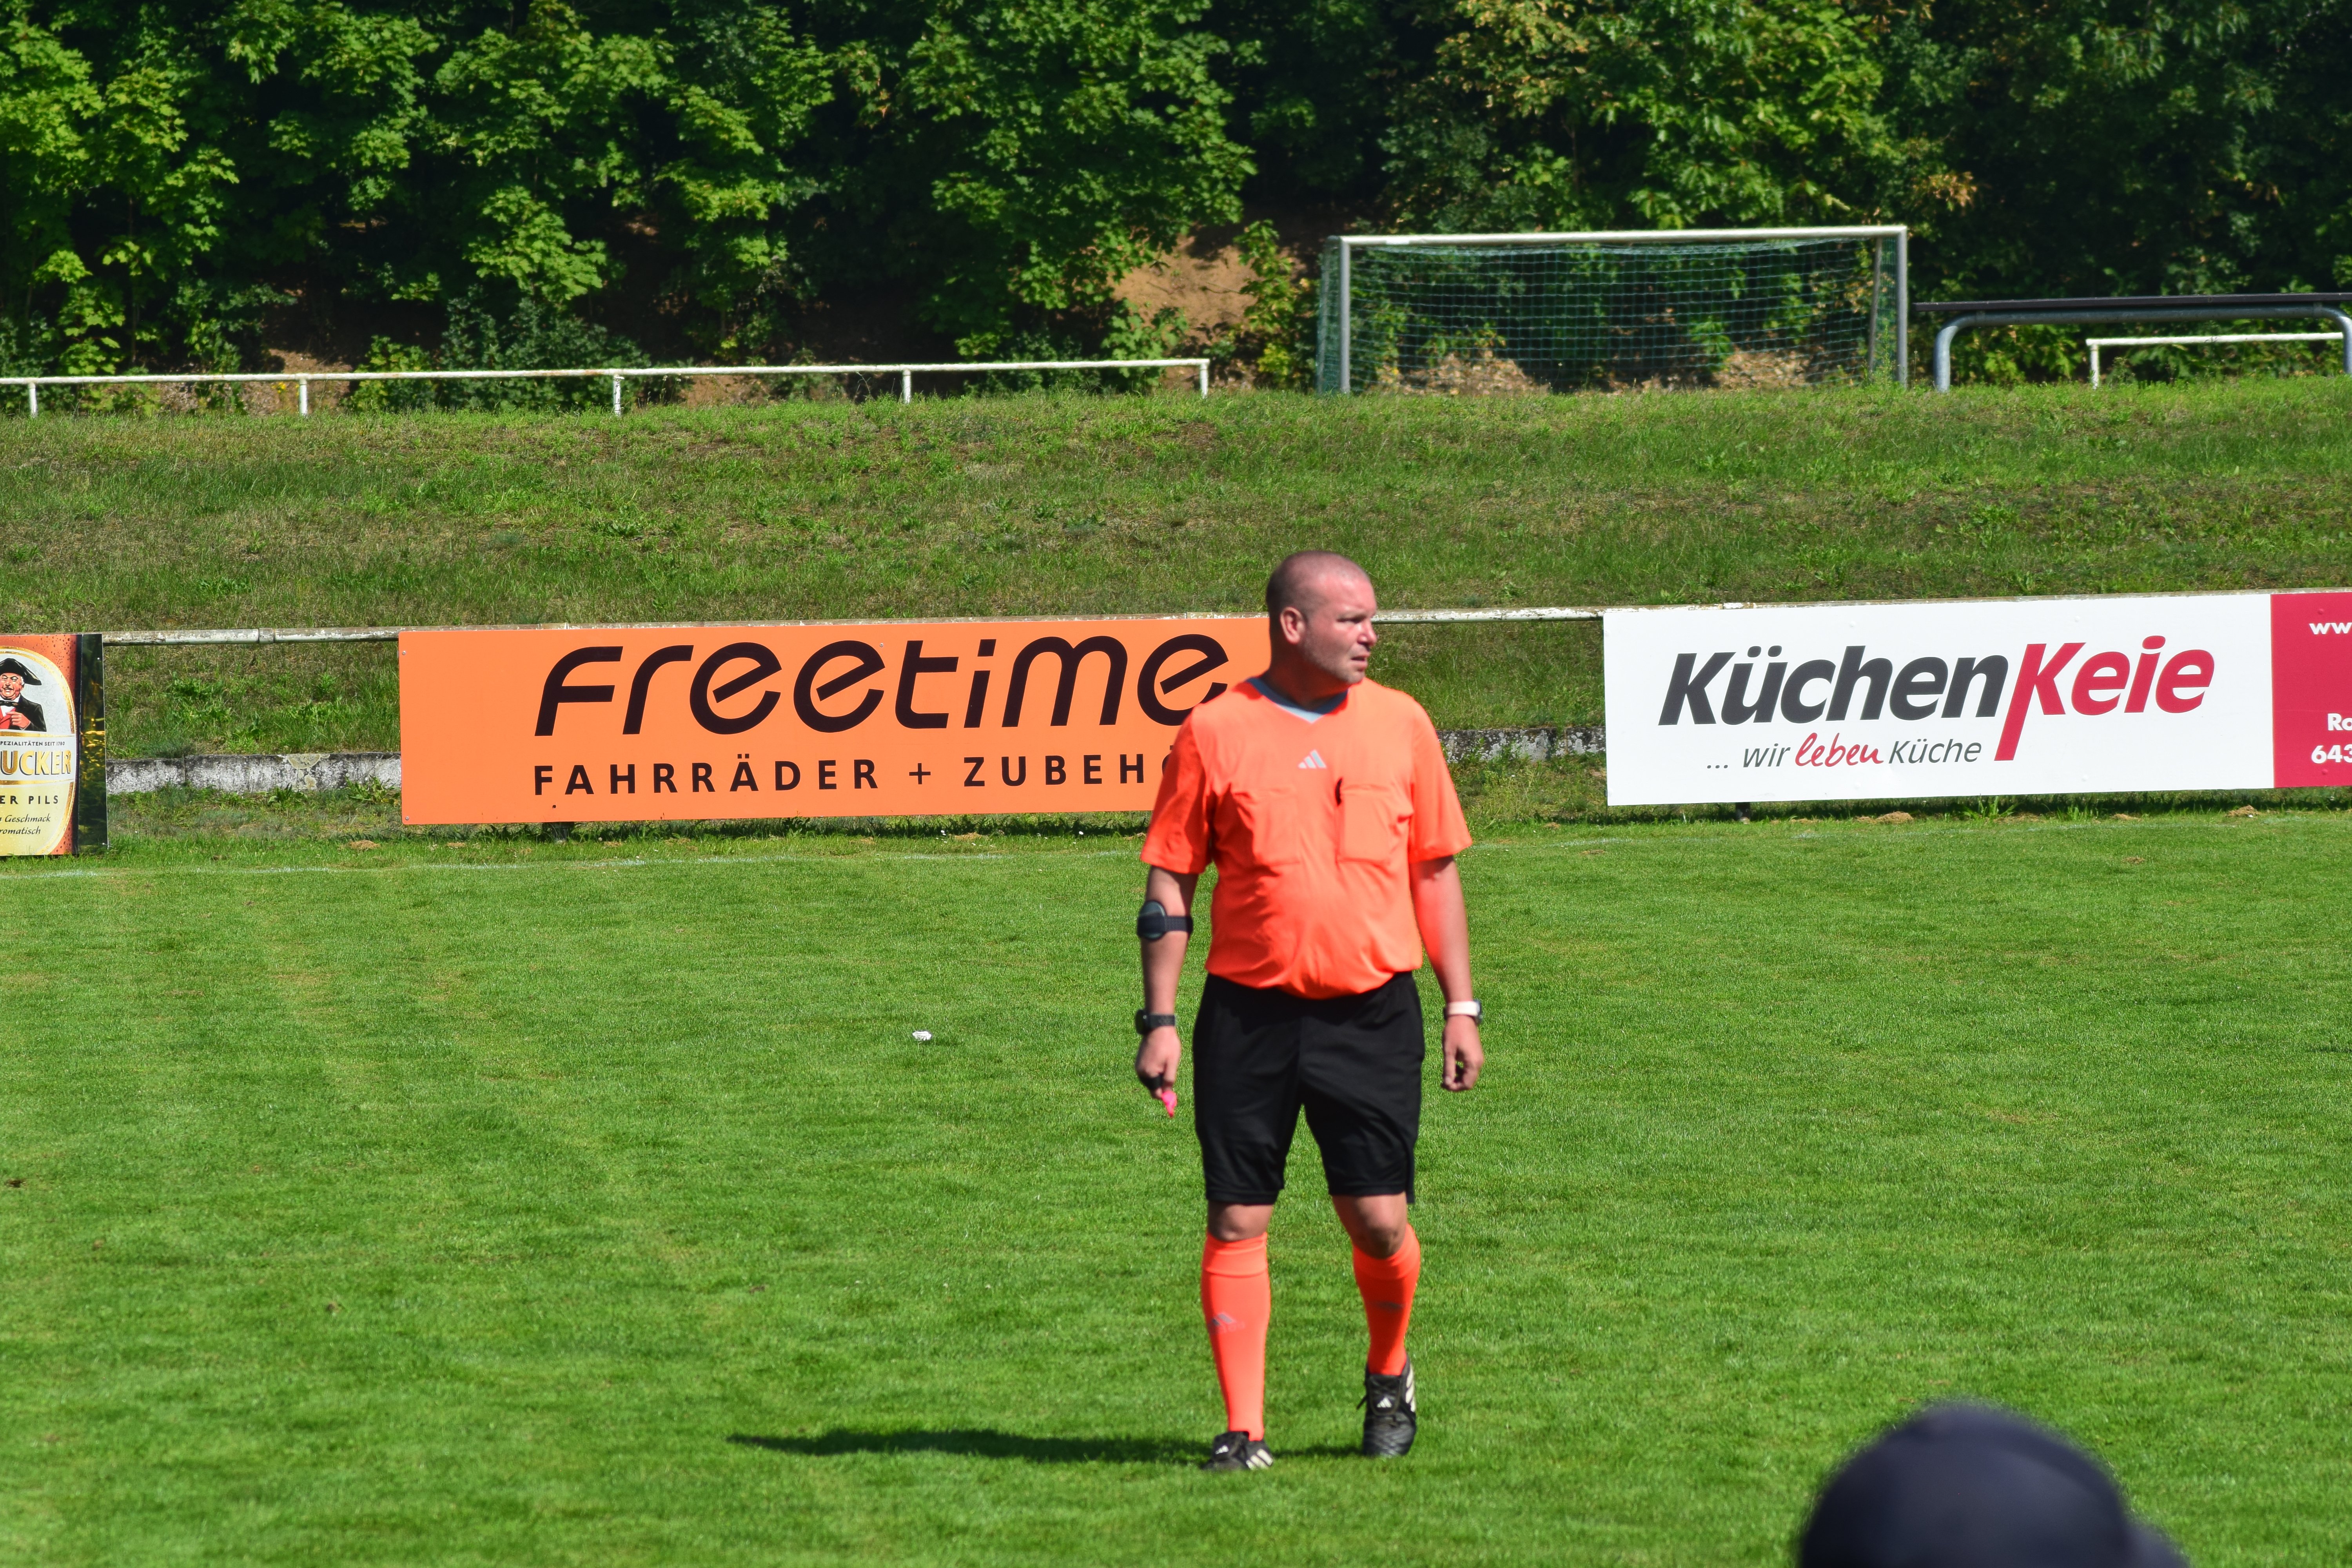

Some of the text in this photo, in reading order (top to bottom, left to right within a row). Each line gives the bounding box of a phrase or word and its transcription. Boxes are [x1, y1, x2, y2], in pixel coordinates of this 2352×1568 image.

[1743, 743, 1791, 768] wir
[1795, 733, 1883, 767] leben
[1889, 739, 1982, 764] Küche
[534, 745, 1174, 795] FAHRRÄDER + ZUBEH
[29, 795, 58, 804] PILS
[5, 813, 51, 822] Geschmack
